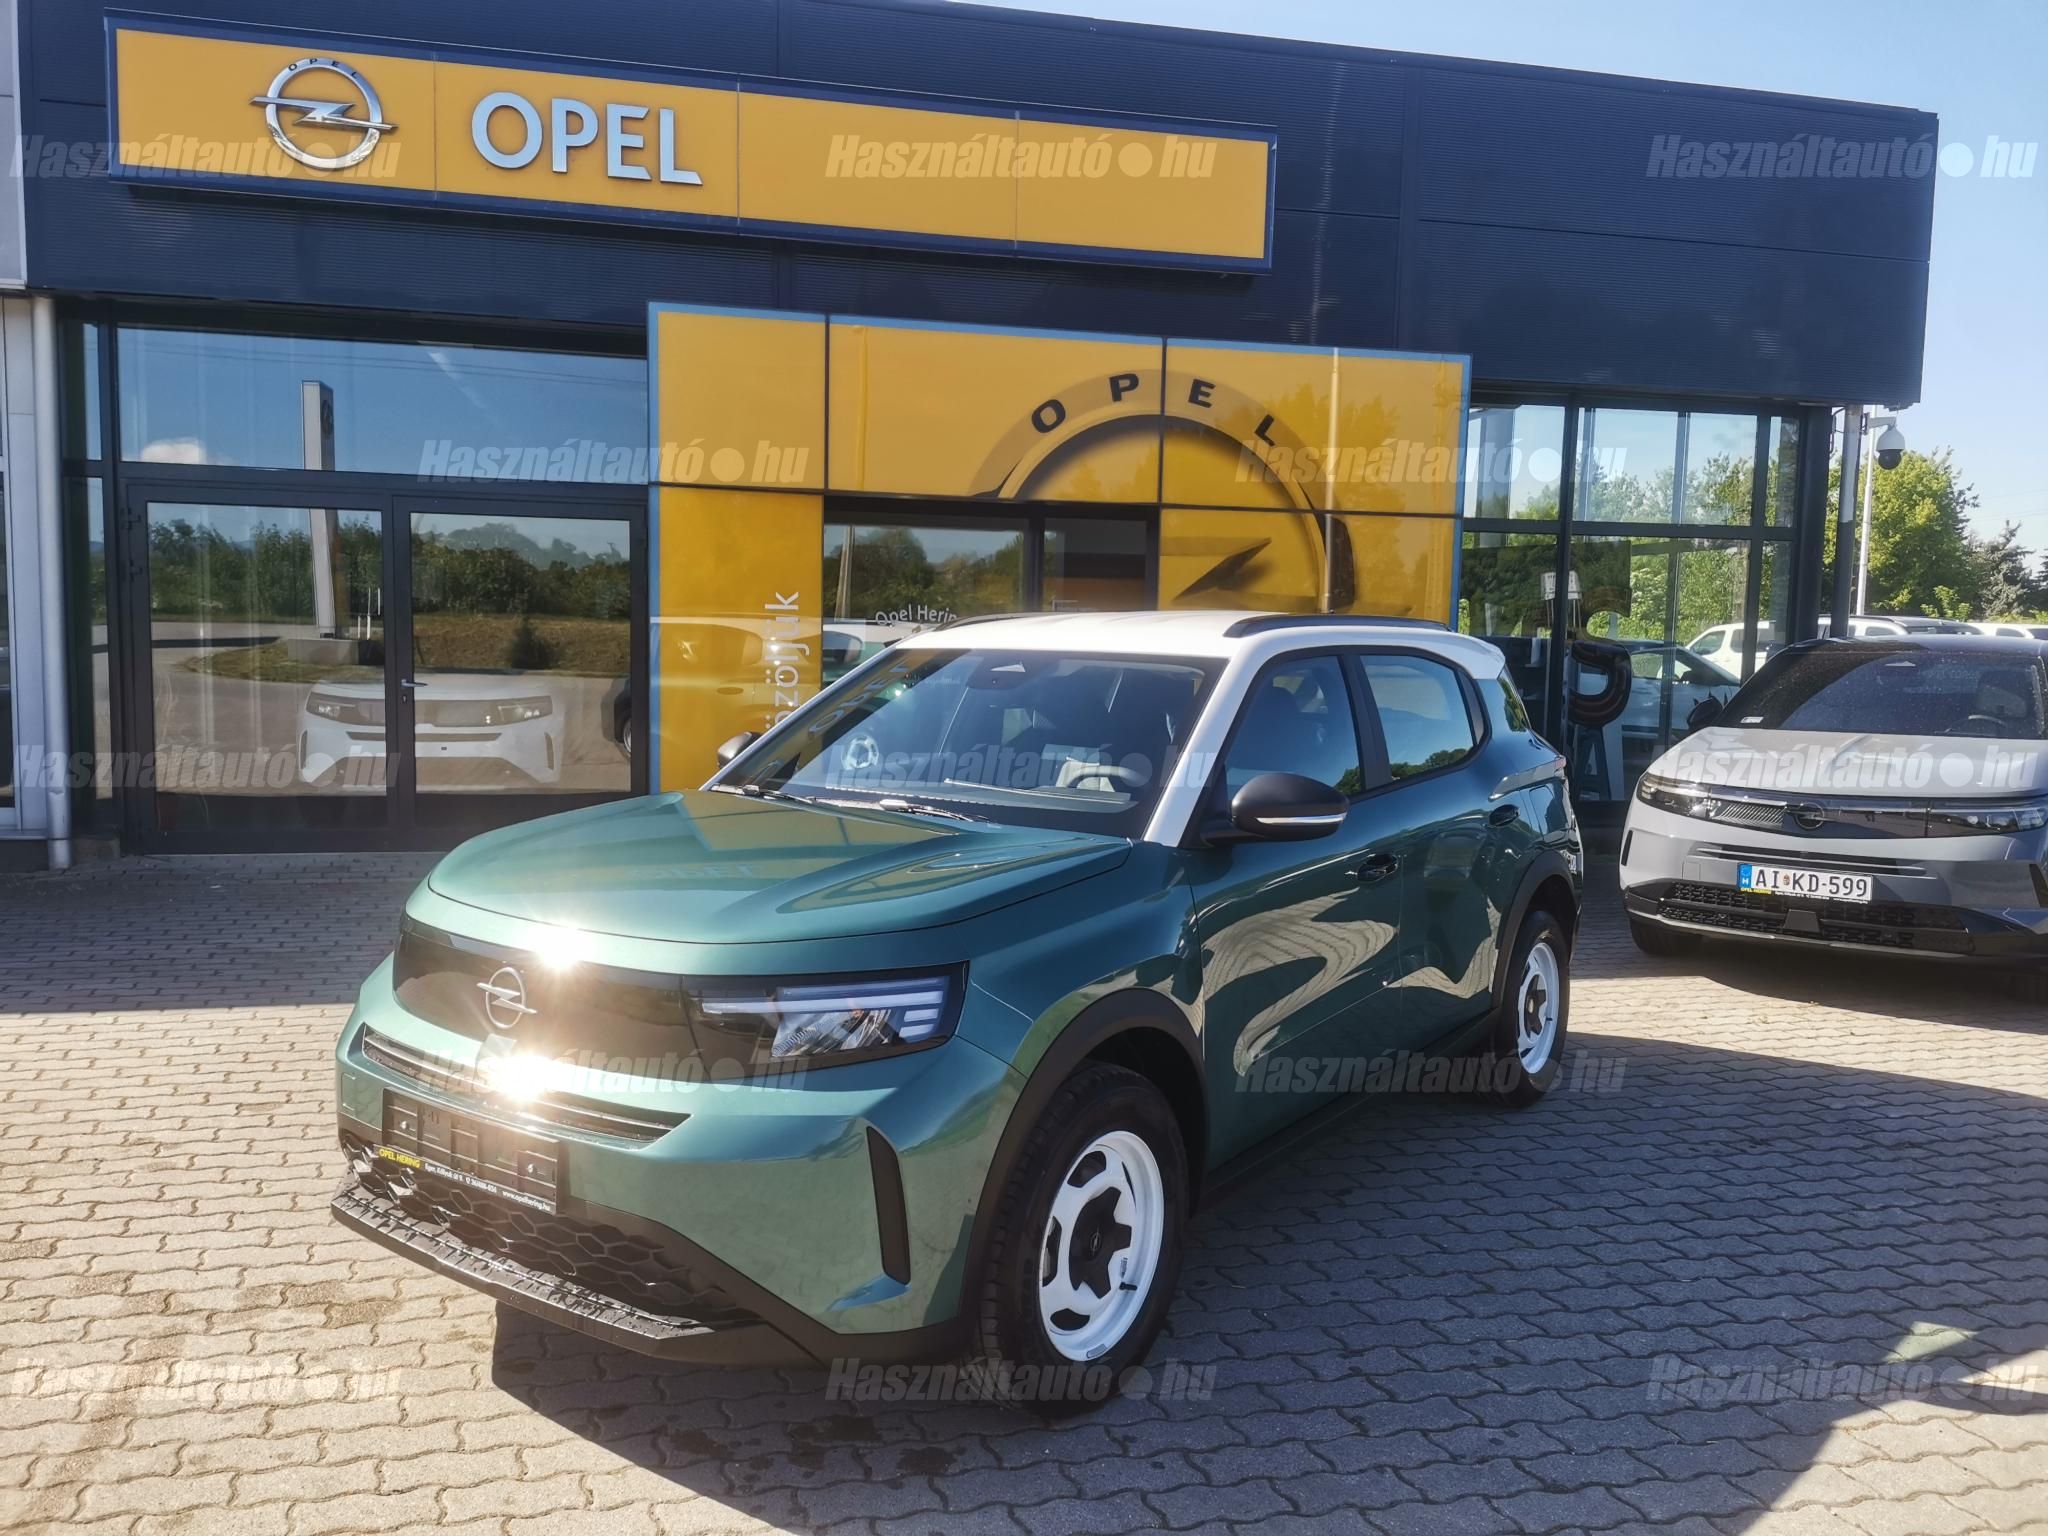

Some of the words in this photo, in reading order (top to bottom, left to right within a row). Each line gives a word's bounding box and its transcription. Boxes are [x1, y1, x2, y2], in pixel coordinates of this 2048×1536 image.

[288, 58, 357, 79] OPEL
[471, 91, 703, 186] OPEL
[1031, 373, 1275, 447] OPEL
[876, 604, 913, 626] Opel
[917, 604, 958, 622] Herin
[764, 592, 810, 730] özöljük
[1755, 869, 1780, 889] AI
[1792, 872, 1868, 898] KD-599
[379, 1148, 396, 1162] OPEL
[395, 1151, 421, 1168] HERING
